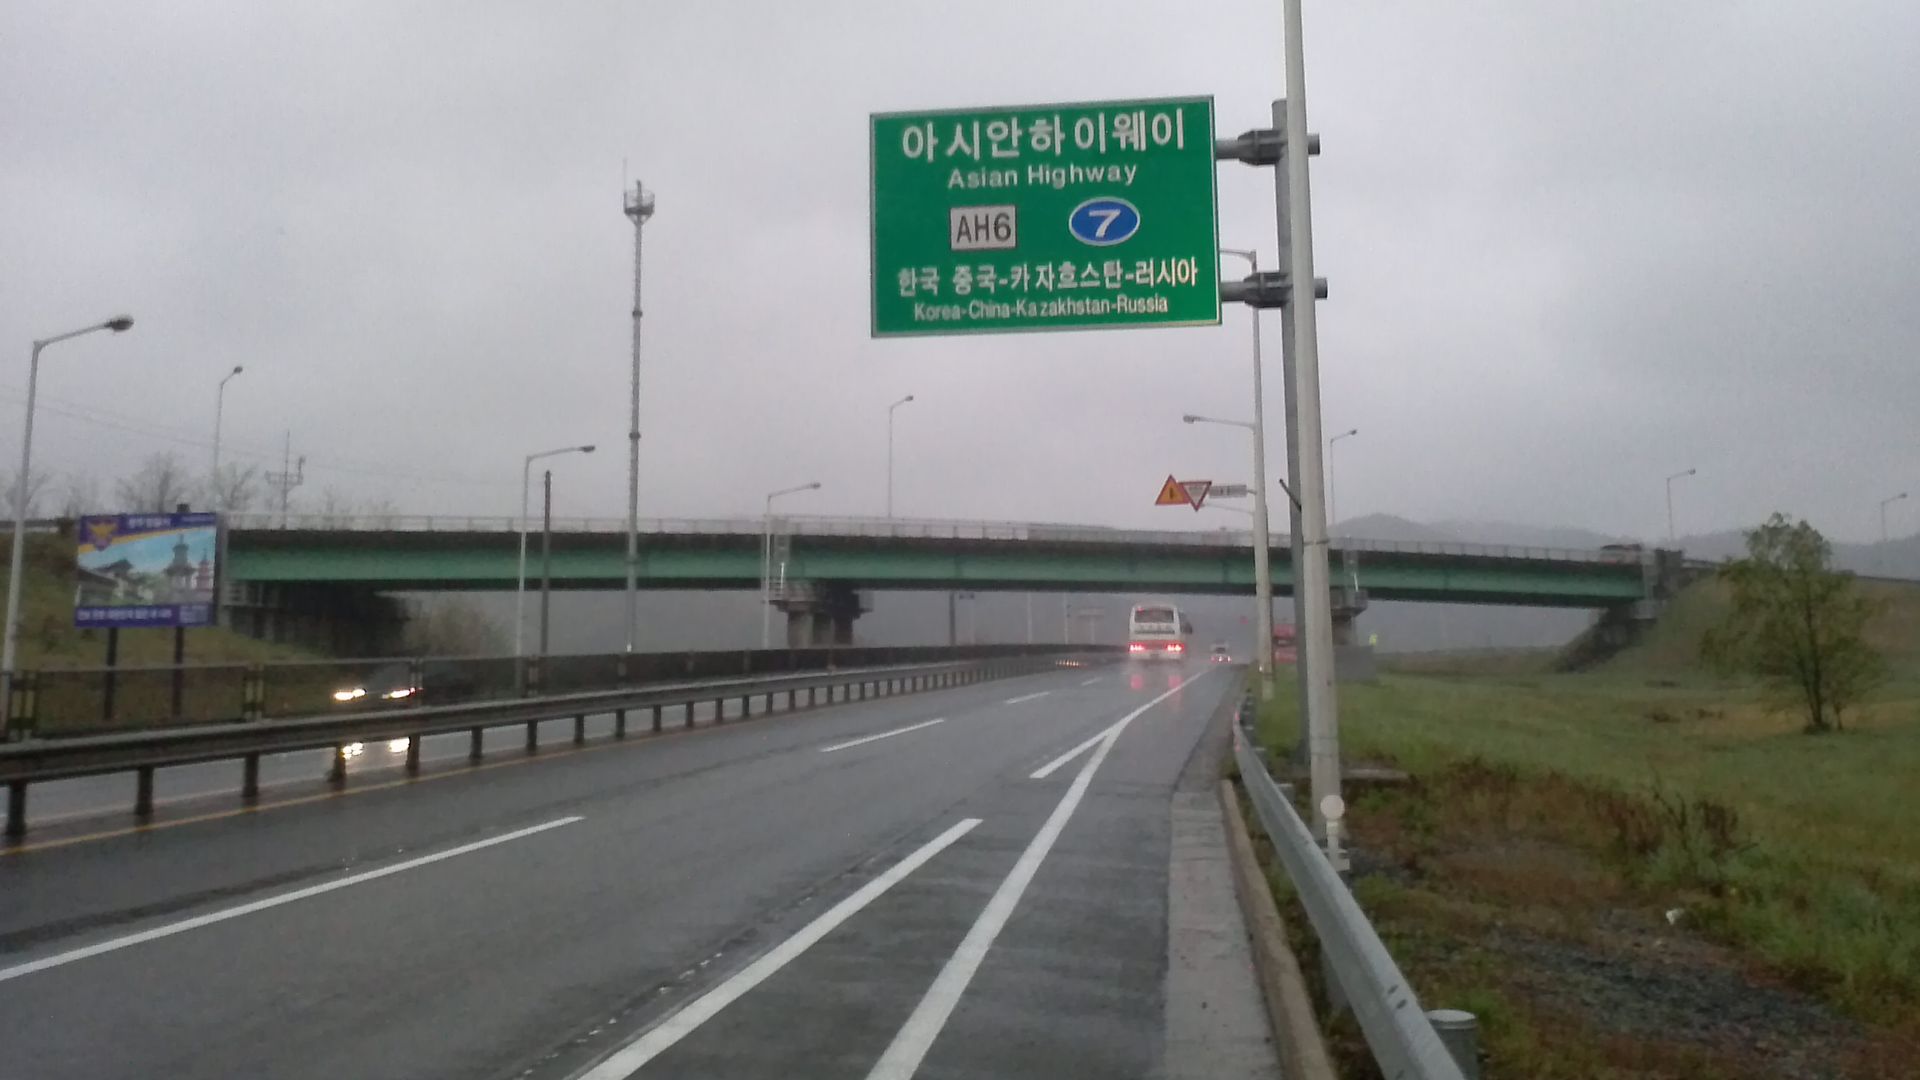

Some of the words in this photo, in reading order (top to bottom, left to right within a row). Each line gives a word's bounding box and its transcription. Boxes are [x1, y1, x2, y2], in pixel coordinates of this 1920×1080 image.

[902, 108, 1185, 162] 아시안하이웨이
[947, 167, 1018, 189] Asian
[1027, 164, 1137, 189] Highway
[956, 212, 1012, 244] AH6
[1088, 209, 1121, 238] 7
[898, 266, 940, 297] 한국
